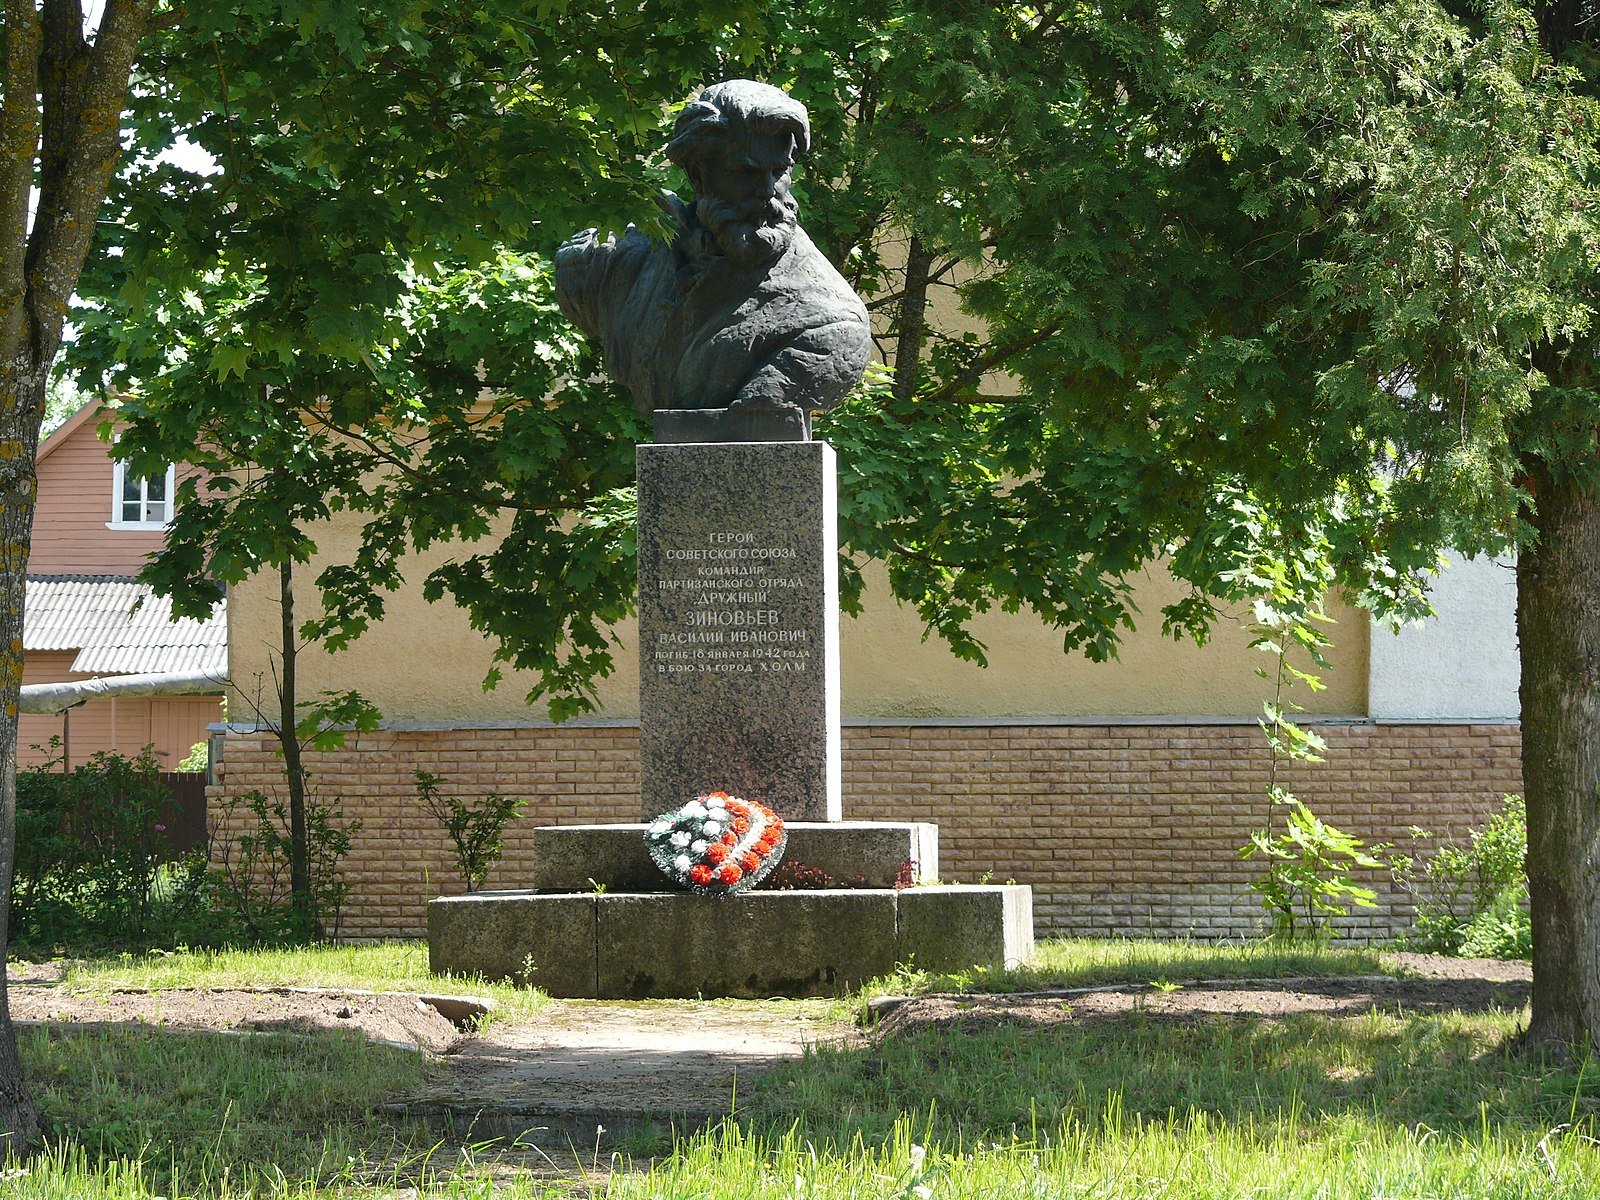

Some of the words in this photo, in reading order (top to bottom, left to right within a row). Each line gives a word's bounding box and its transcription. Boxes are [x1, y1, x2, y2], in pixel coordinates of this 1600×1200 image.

[709, 530, 754, 543] ГЕРОЙ
[666, 549, 748, 560] СОВЕТСКОГО
[751, 548, 797, 559] СОЮЗА
[698, 566, 764, 576] КОМАНДИР
[659, 579, 754, 589] ПАРТИЗАНСКОГО
[758, 578, 803, 588] ОТРЯДА
[685, 610, 779, 626] ЗИНОВЬЕВ
[660, 630, 723, 644] ВАСИЛИЙ
[731, 630, 806, 643] ИВАНОВИЧ
[655, 651, 688, 659] ПОГИБ
[707, 650, 749, 659] ЯНВАРЯ
[752, 648, 780, 658] 1942
[783, 650, 810, 658] ГОДА
[668, 664, 695, 672] БОЮ
[698, 664, 712, 672] ЗА
[715, 664, 753, 672] ГОРОД
[760, 662, 805, 671] ХОЛМ
